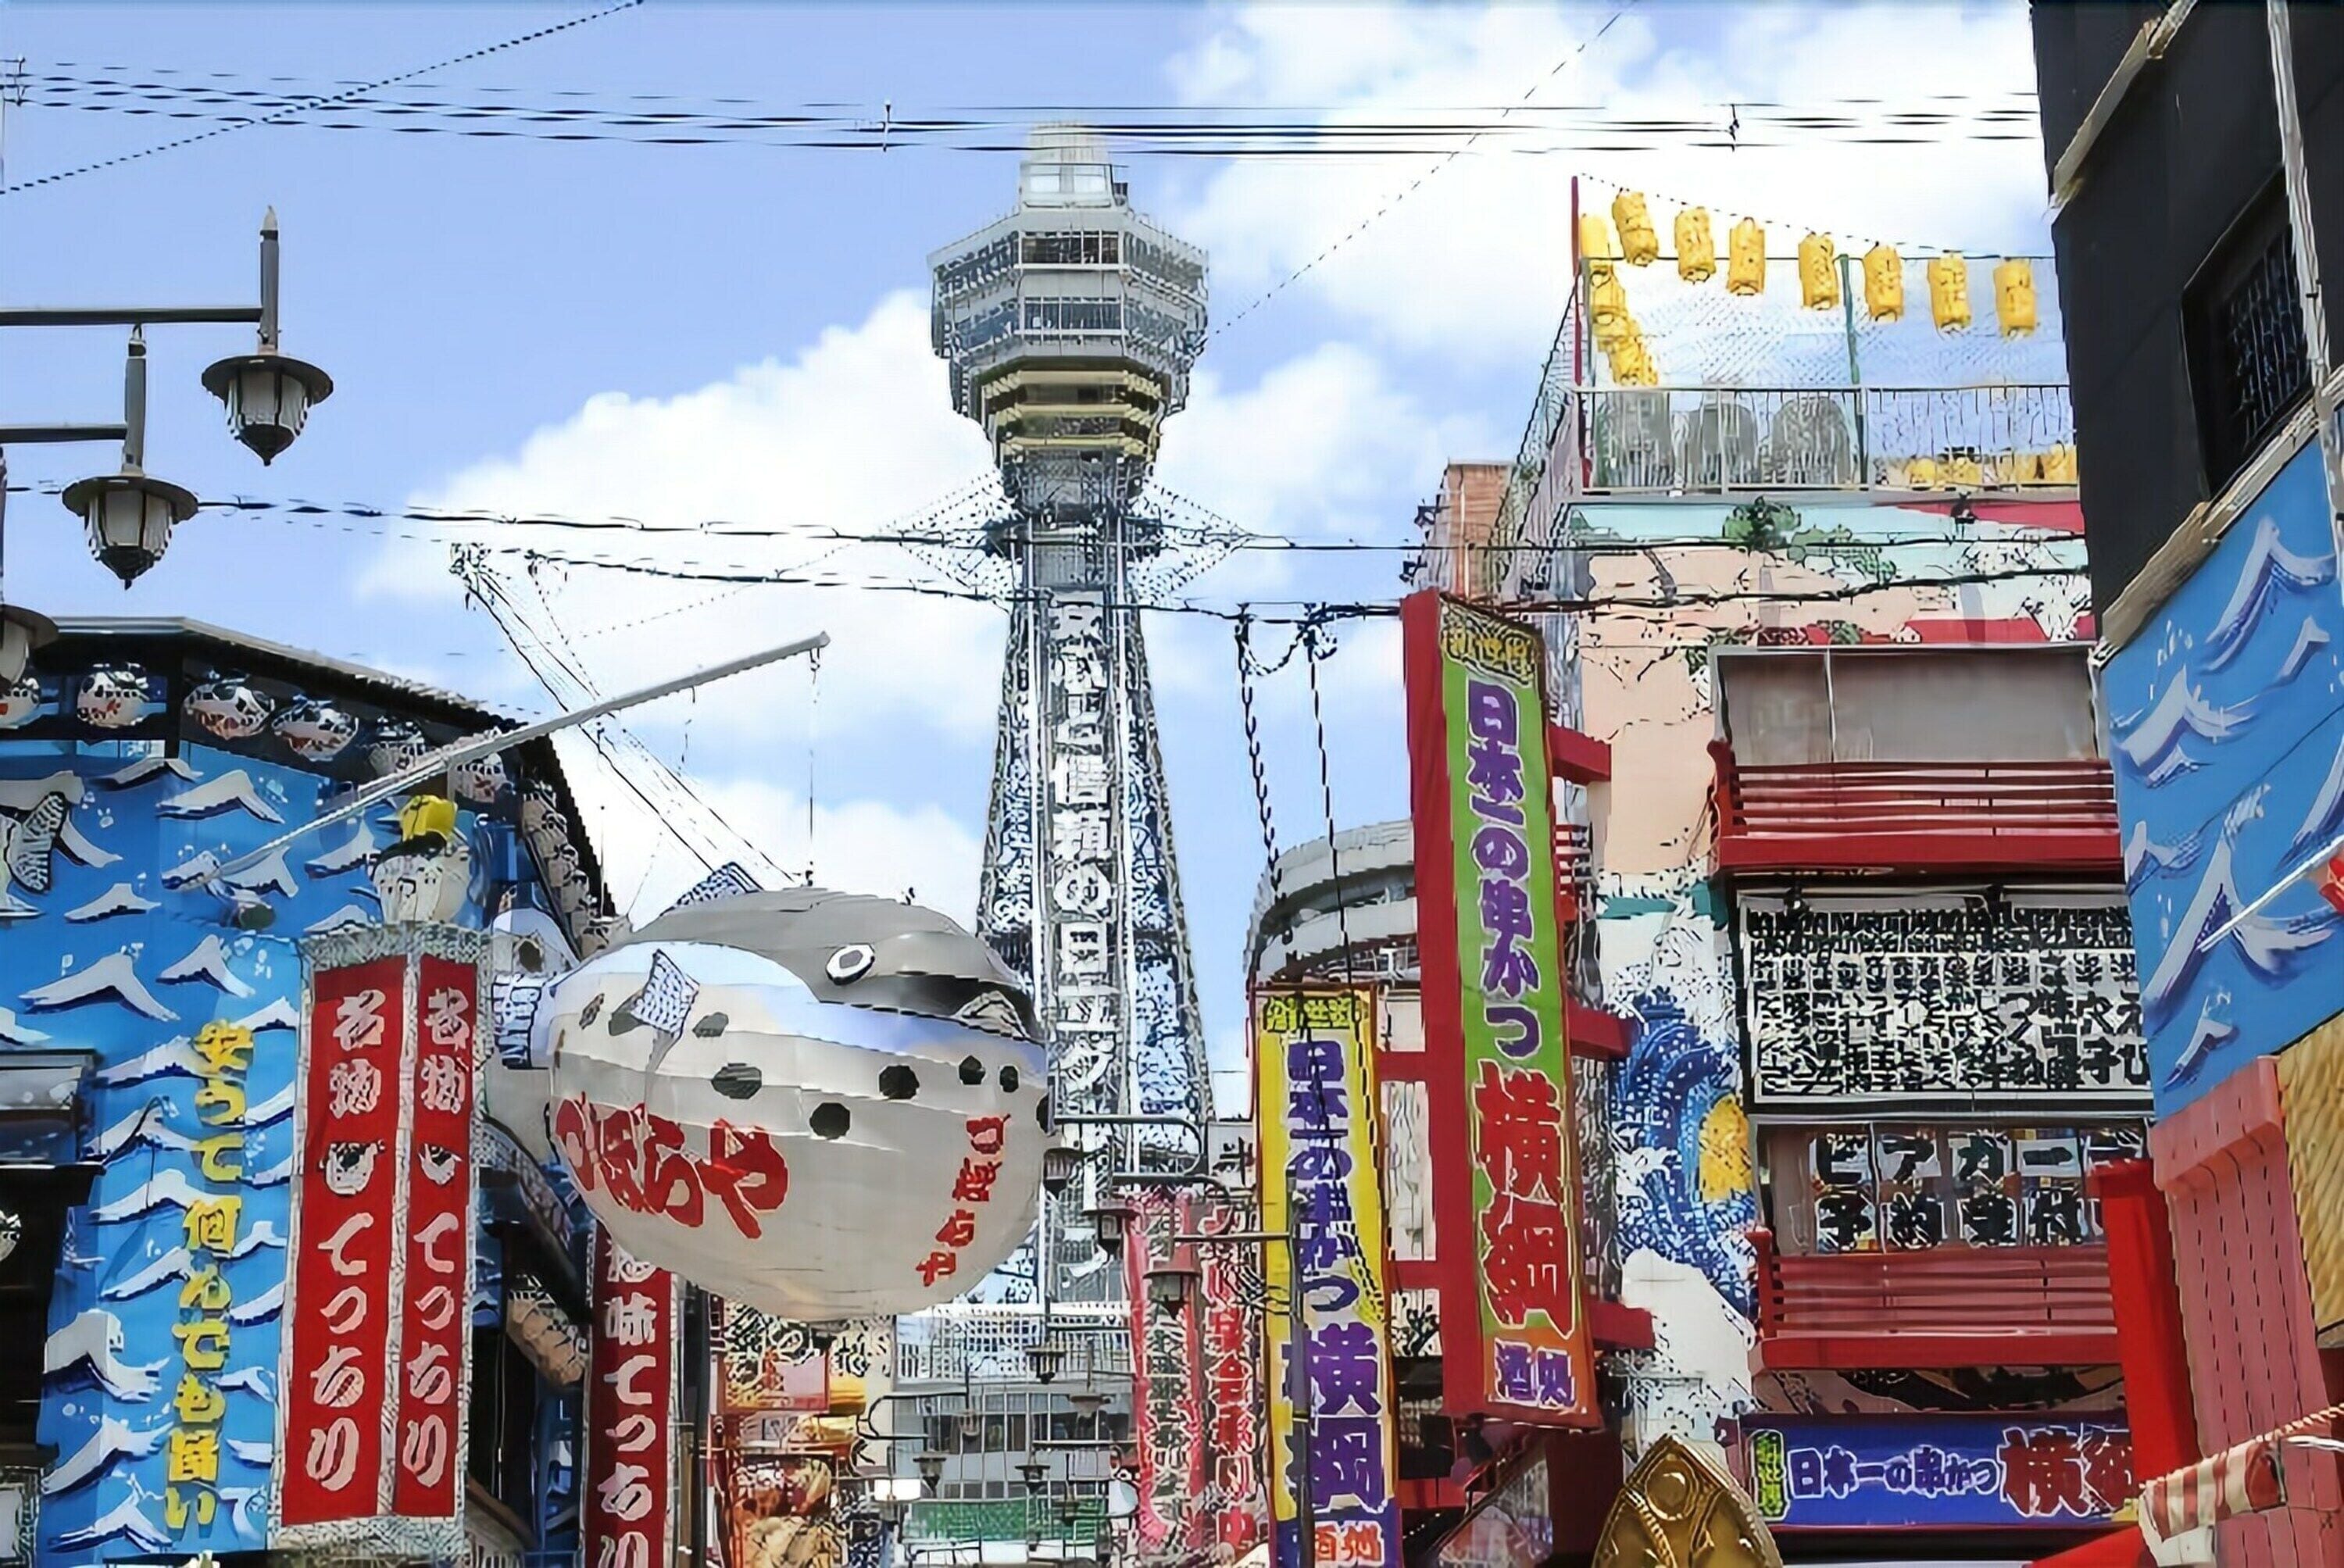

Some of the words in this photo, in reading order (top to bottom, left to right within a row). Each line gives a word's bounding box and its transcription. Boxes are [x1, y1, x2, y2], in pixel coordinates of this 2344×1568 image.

[1788, 1444, 1999, 1499] 日本一の串かつ
